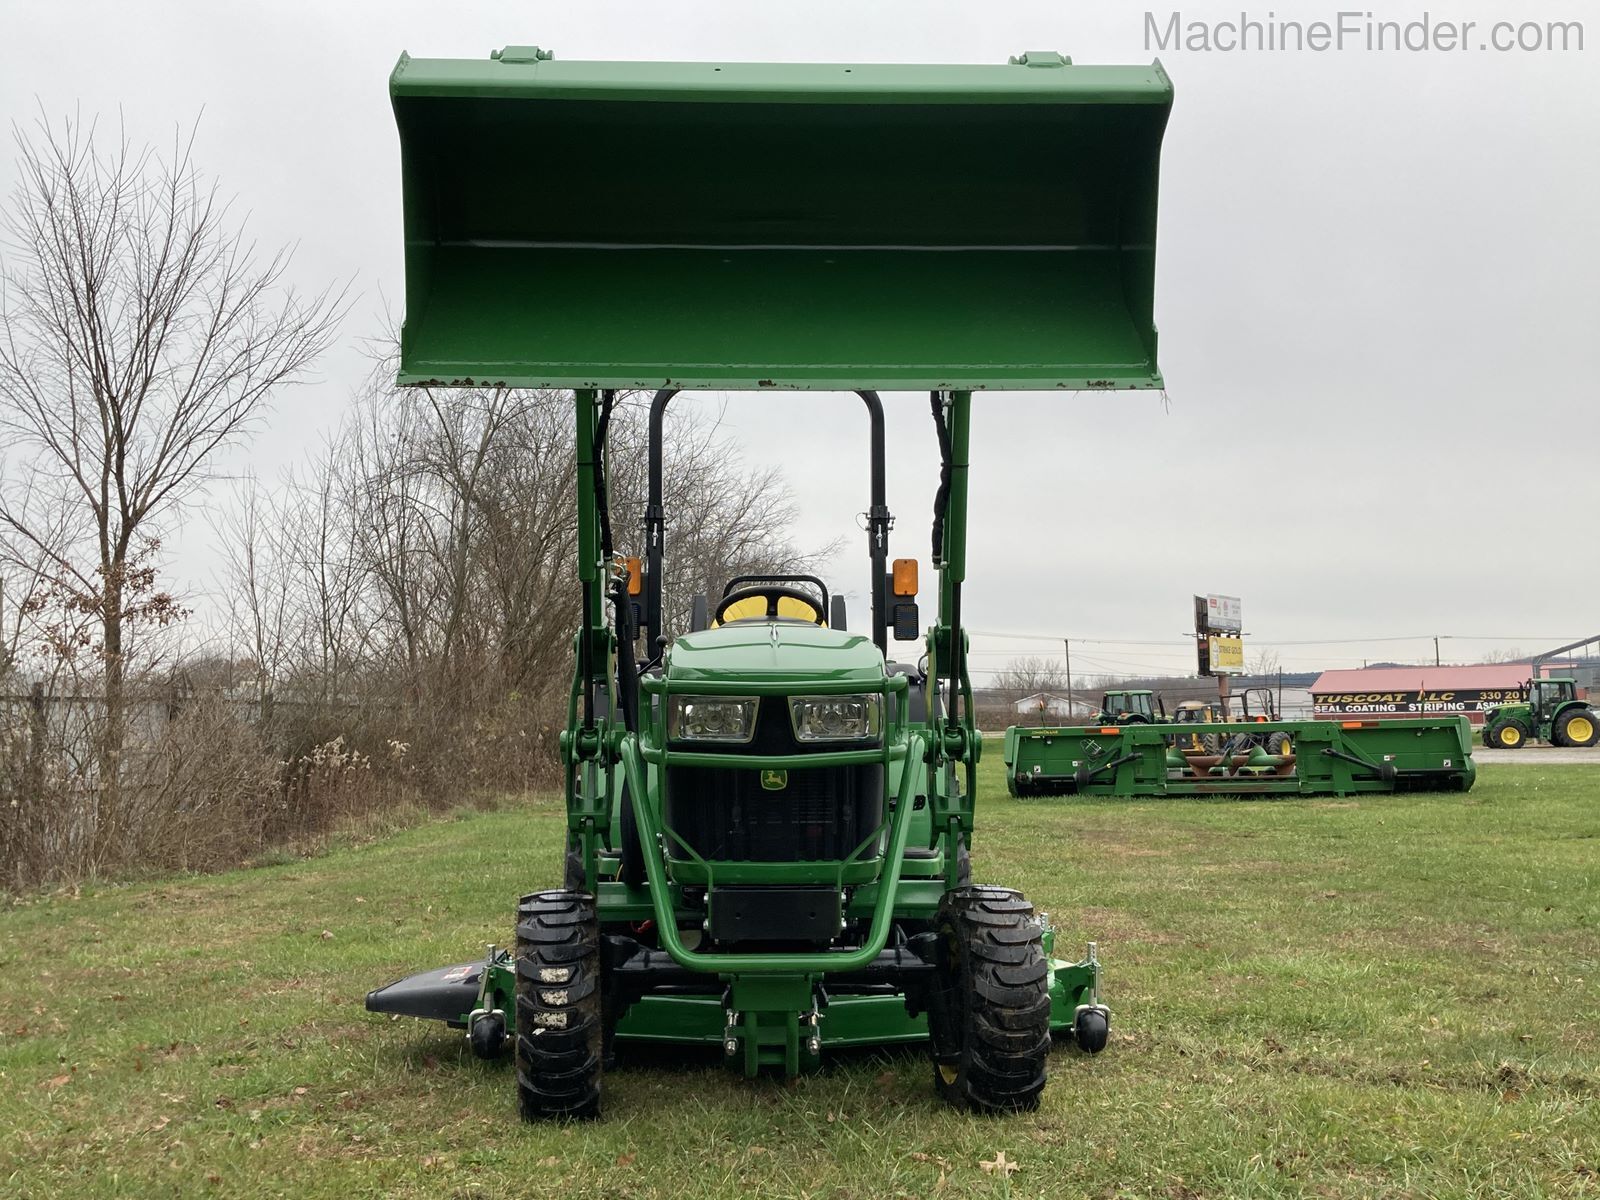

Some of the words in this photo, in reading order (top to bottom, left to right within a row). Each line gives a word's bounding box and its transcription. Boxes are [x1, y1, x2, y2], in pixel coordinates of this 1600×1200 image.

[1316, 693, 1407, 703] TUSCOAT
[1480, 691, 1501, 700] 330
[1314, 704, 1342, 713] SEAL
[1345, 703, 1396, 712] COATING
[1408, 702, 1465, 711] STRIPING
